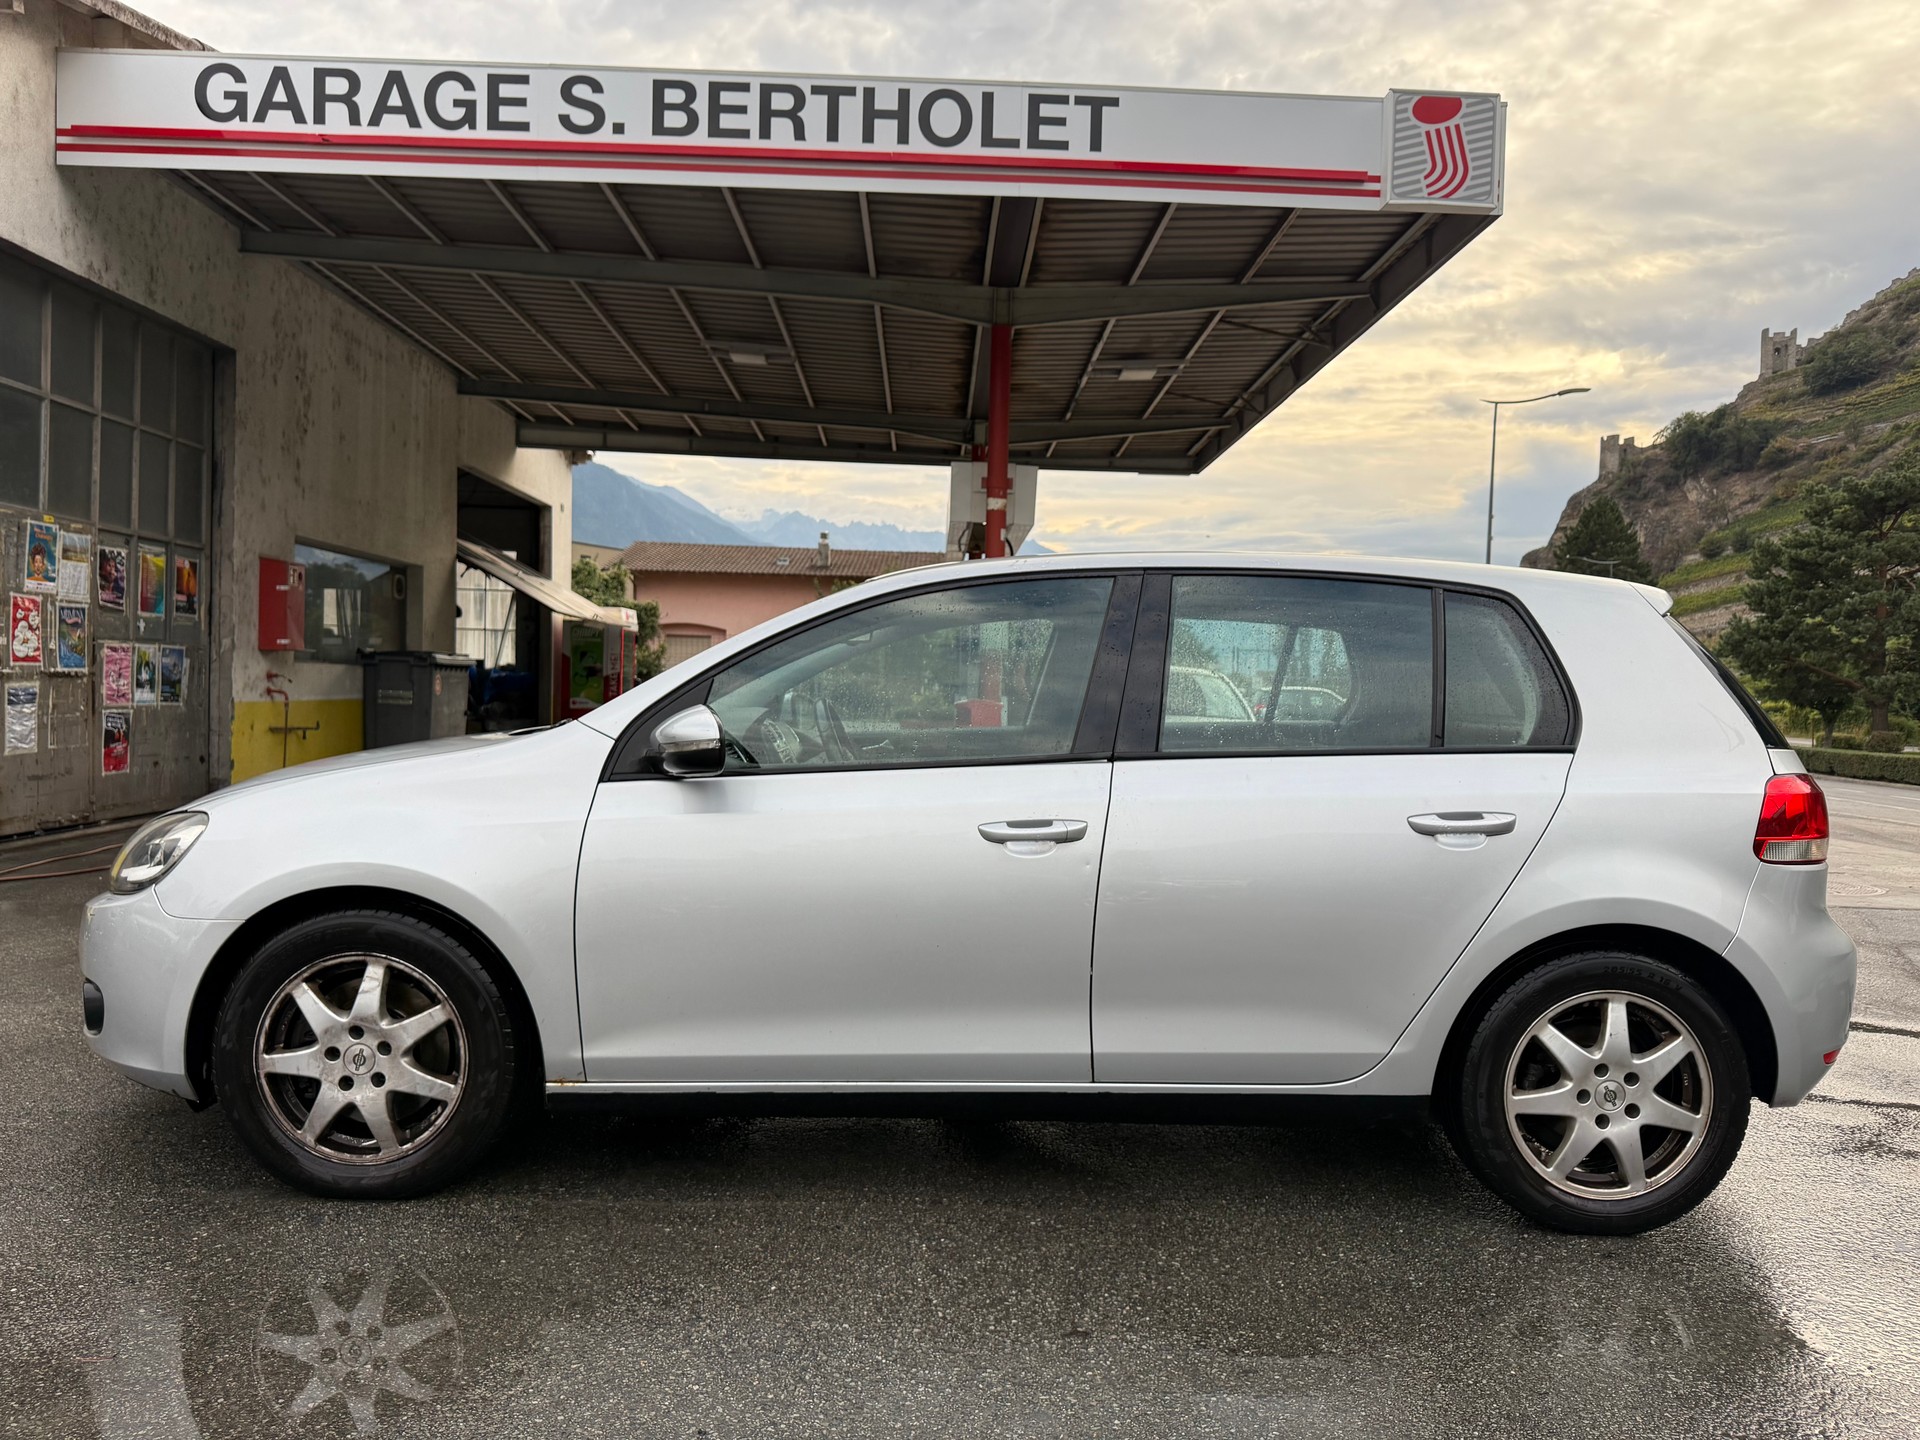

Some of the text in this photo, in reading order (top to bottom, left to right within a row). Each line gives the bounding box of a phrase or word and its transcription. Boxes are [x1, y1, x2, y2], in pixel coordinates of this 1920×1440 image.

[194, 63, 1120, 153] GARAGE S. BERTHOLET
